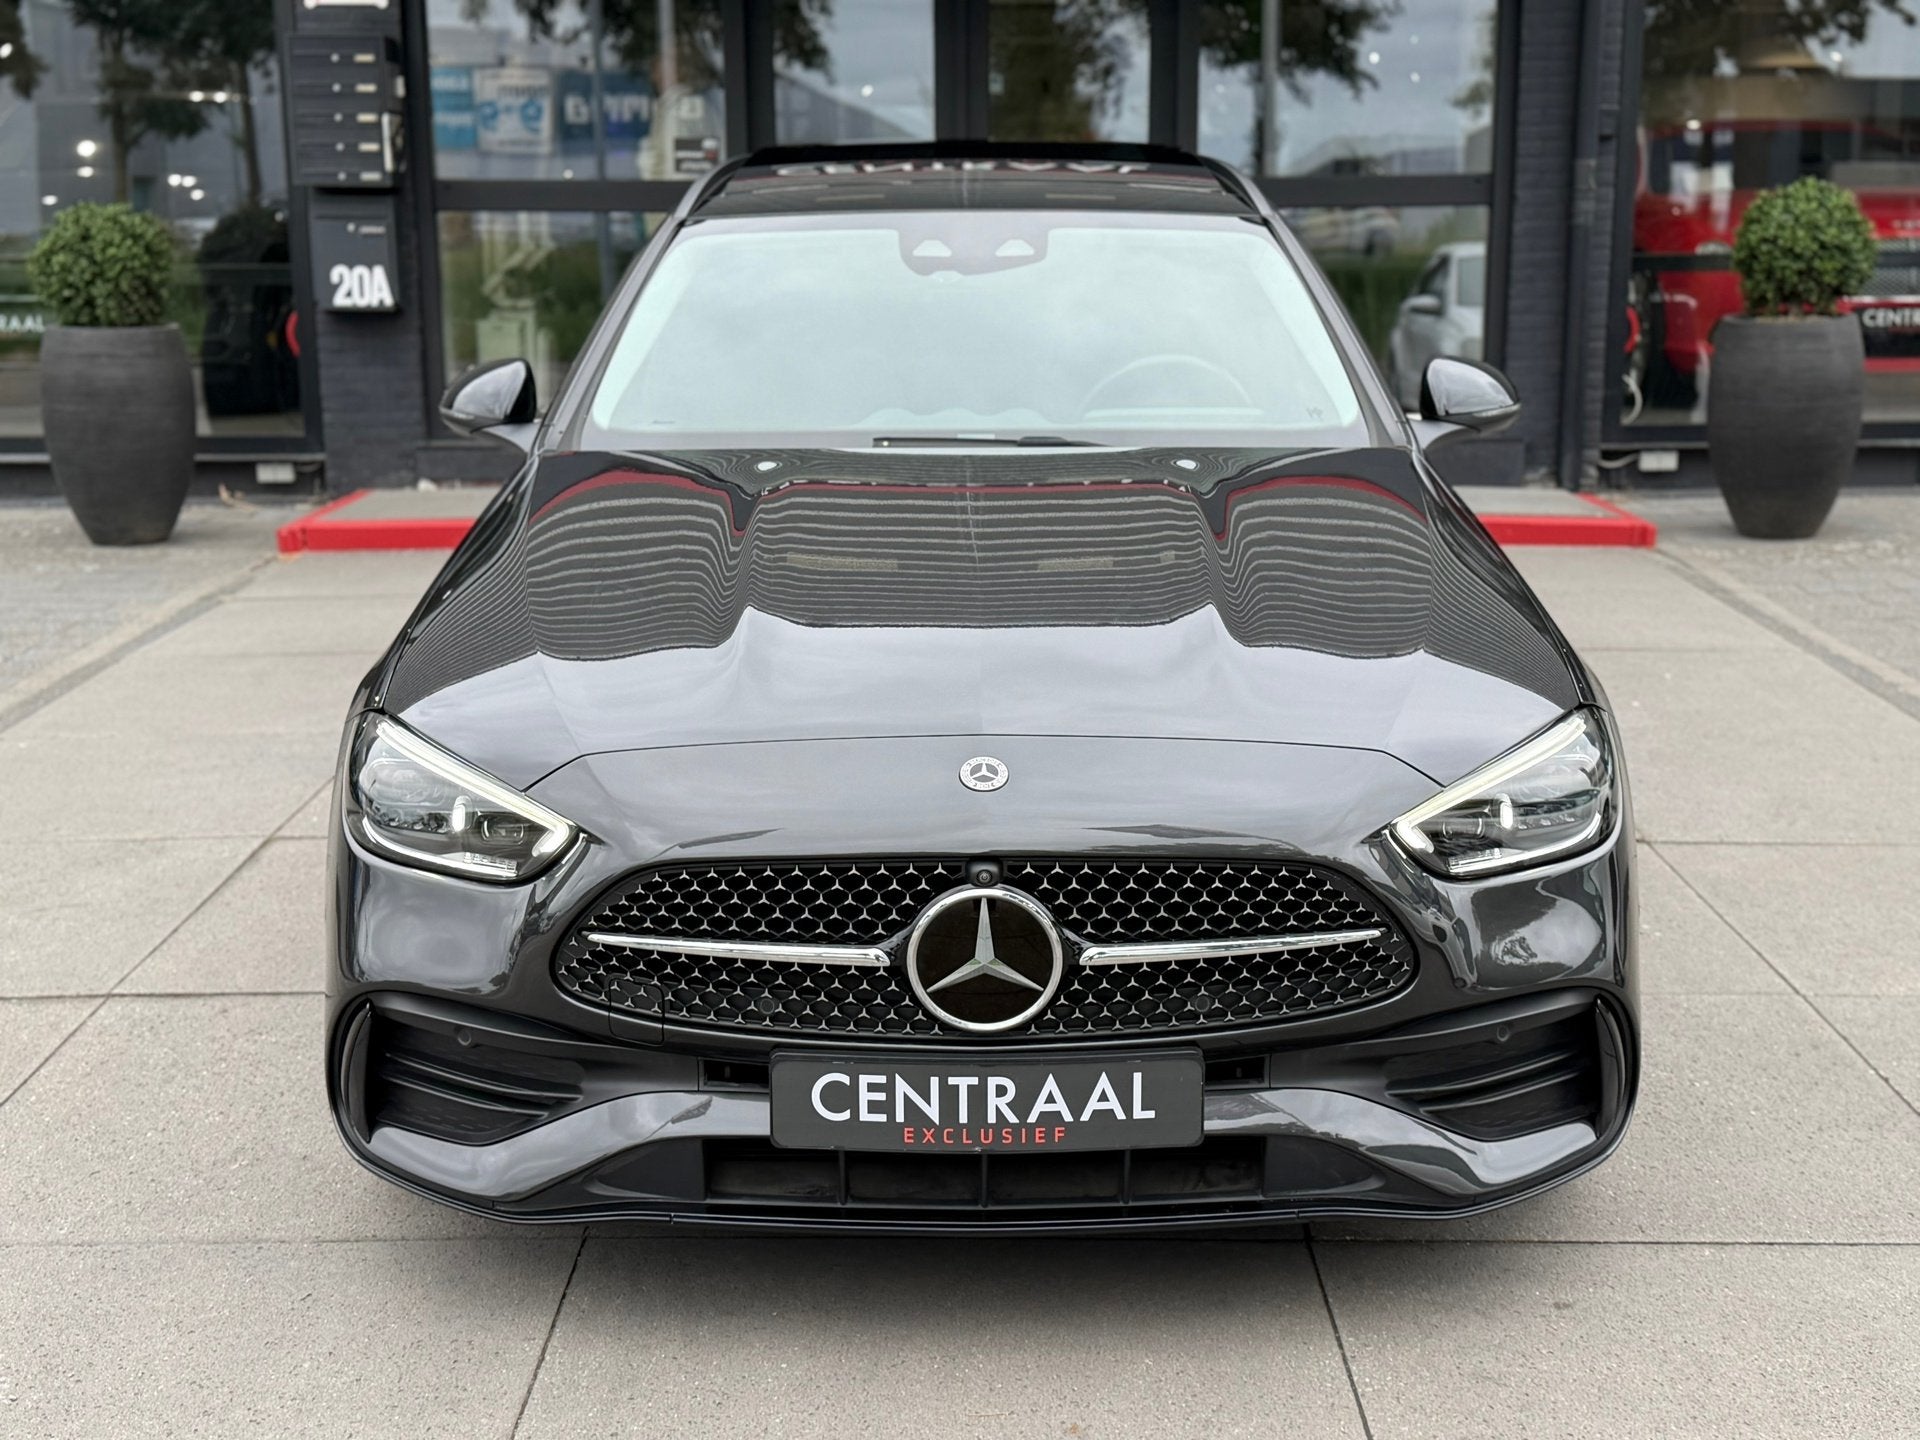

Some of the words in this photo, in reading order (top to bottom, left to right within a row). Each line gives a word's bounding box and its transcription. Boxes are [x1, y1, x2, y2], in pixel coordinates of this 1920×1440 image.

[329, 263, 394, 307] 20A
[810, 1070, 1157, 1126] CENTRAAL
[903, 1126, 1067, 1145] EXCLUSIEF
